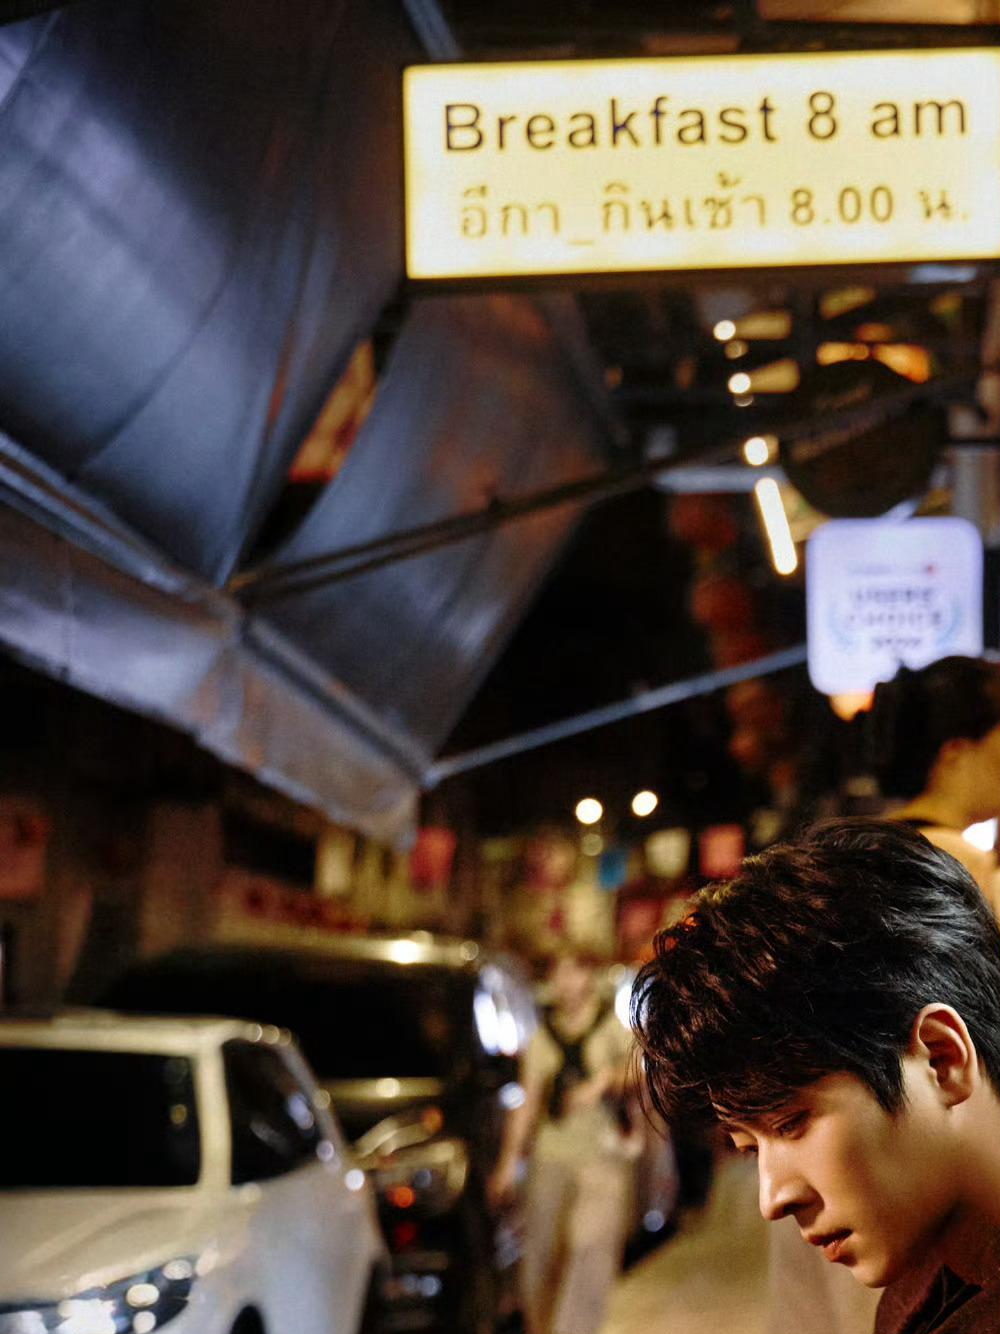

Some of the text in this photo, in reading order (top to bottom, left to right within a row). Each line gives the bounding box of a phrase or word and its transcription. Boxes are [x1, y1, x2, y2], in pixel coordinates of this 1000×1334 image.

[444, 91, 966, 151] Breakfast 8 am
[790, 185, 895, 226] 8.00
